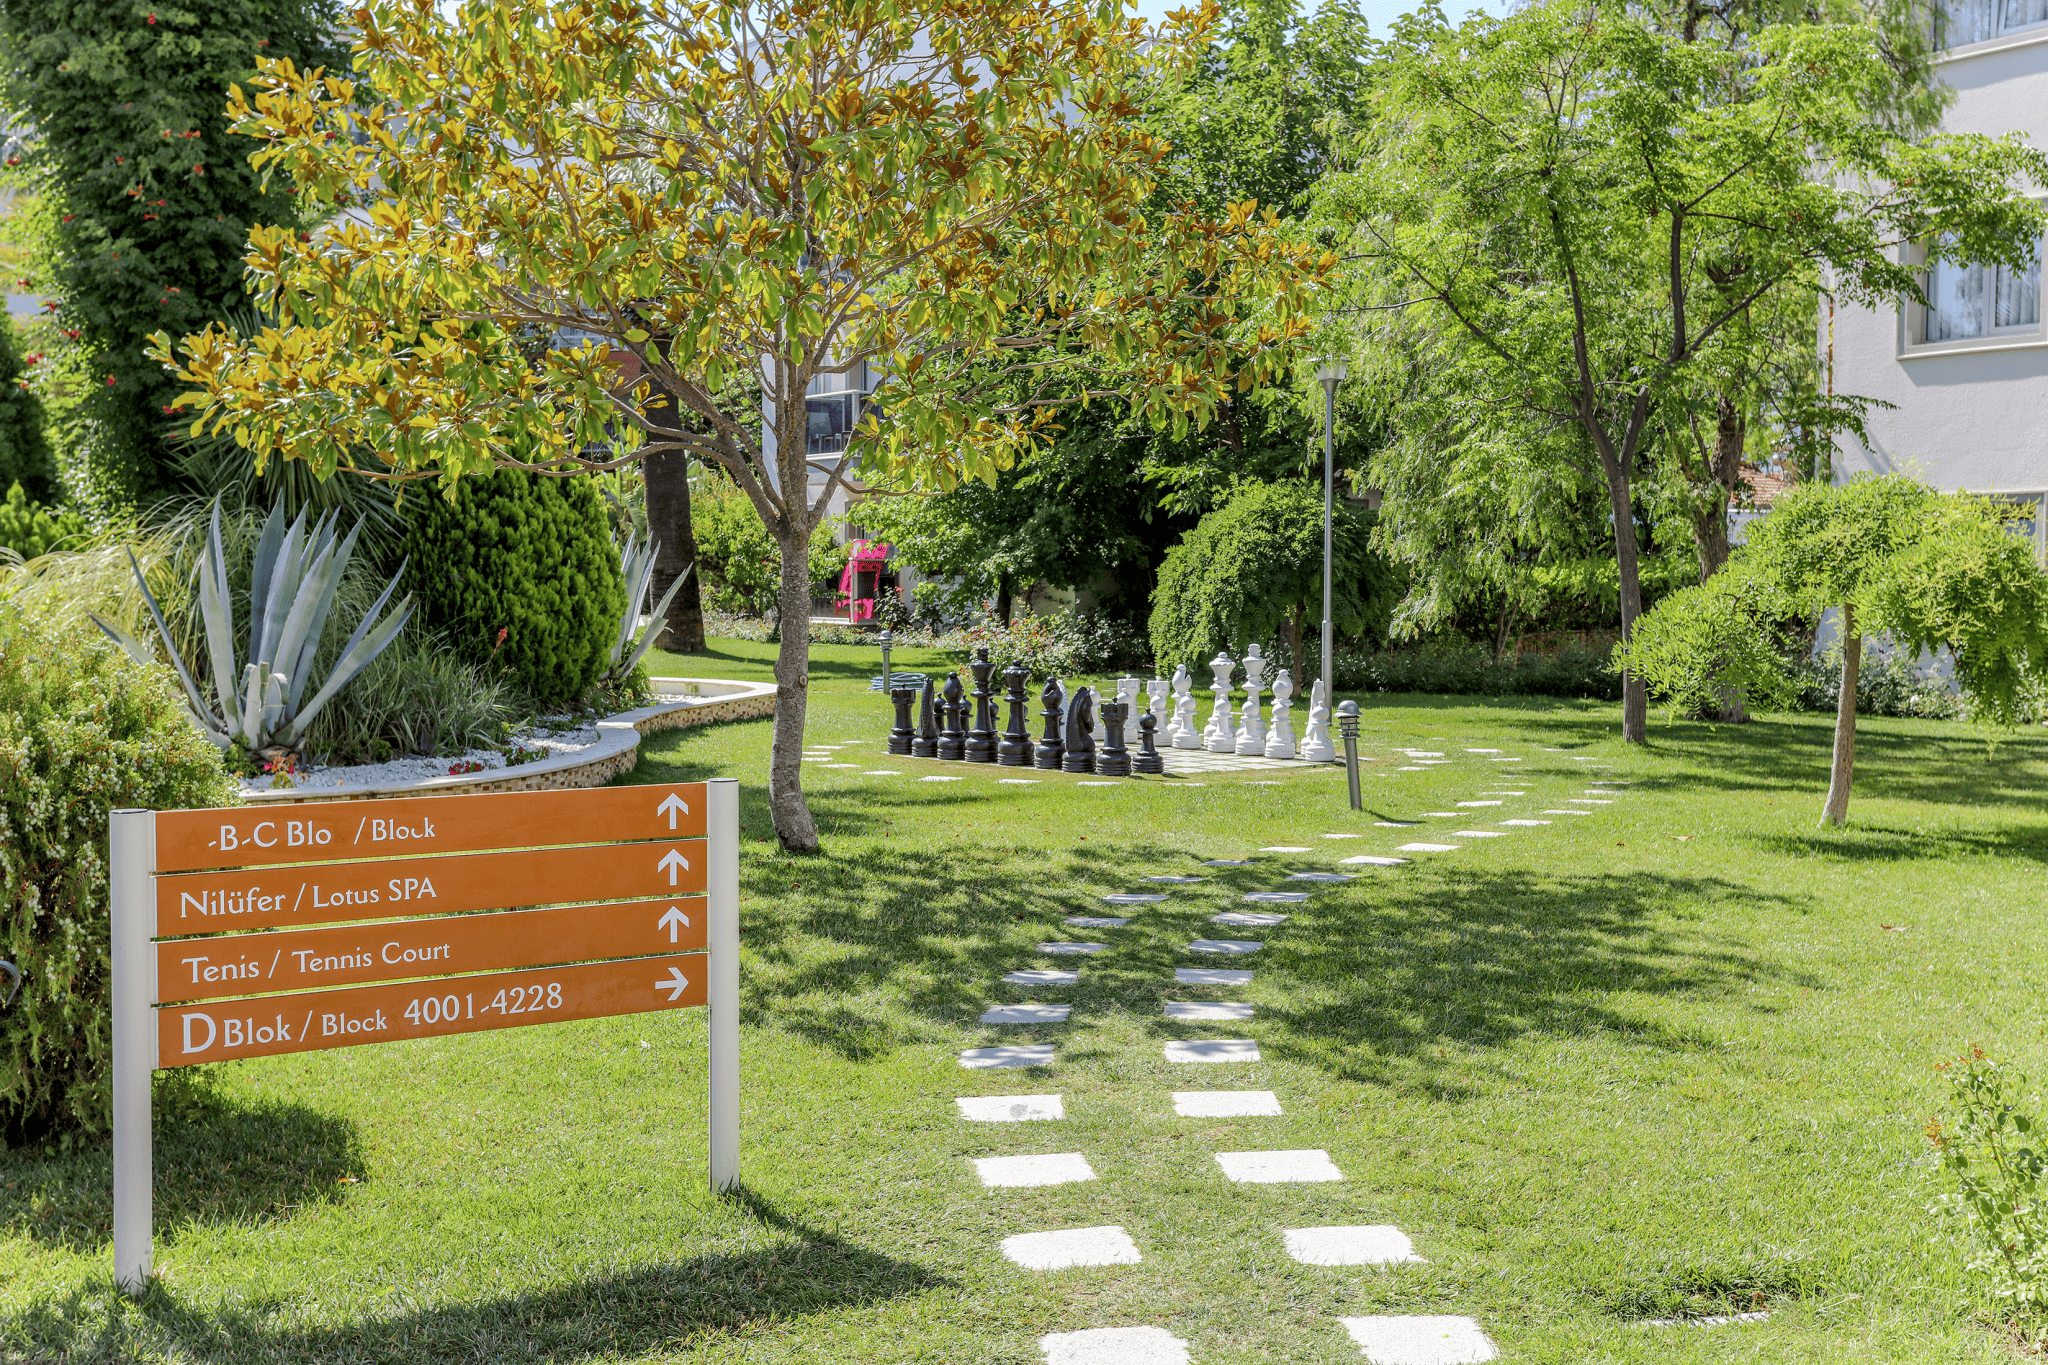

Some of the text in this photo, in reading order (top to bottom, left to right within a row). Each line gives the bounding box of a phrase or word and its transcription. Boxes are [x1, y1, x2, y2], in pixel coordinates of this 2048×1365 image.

[180, 886, 286, 918] Nilüfer
[312, 884, 380, 908] Lotus
[388, 876, 438, 902] SPA
[181, 954, 260, 984] Tenis
[290, 946, 373, 973] Tennis
[381, 941, 451, 965] Court
[181, 1012, 217, 1055] D
[223, 1013, 292, 1048] Blok
[321, 1008, 388, 1037] Block
[403, 982, 563, 1026] 4001-4228
